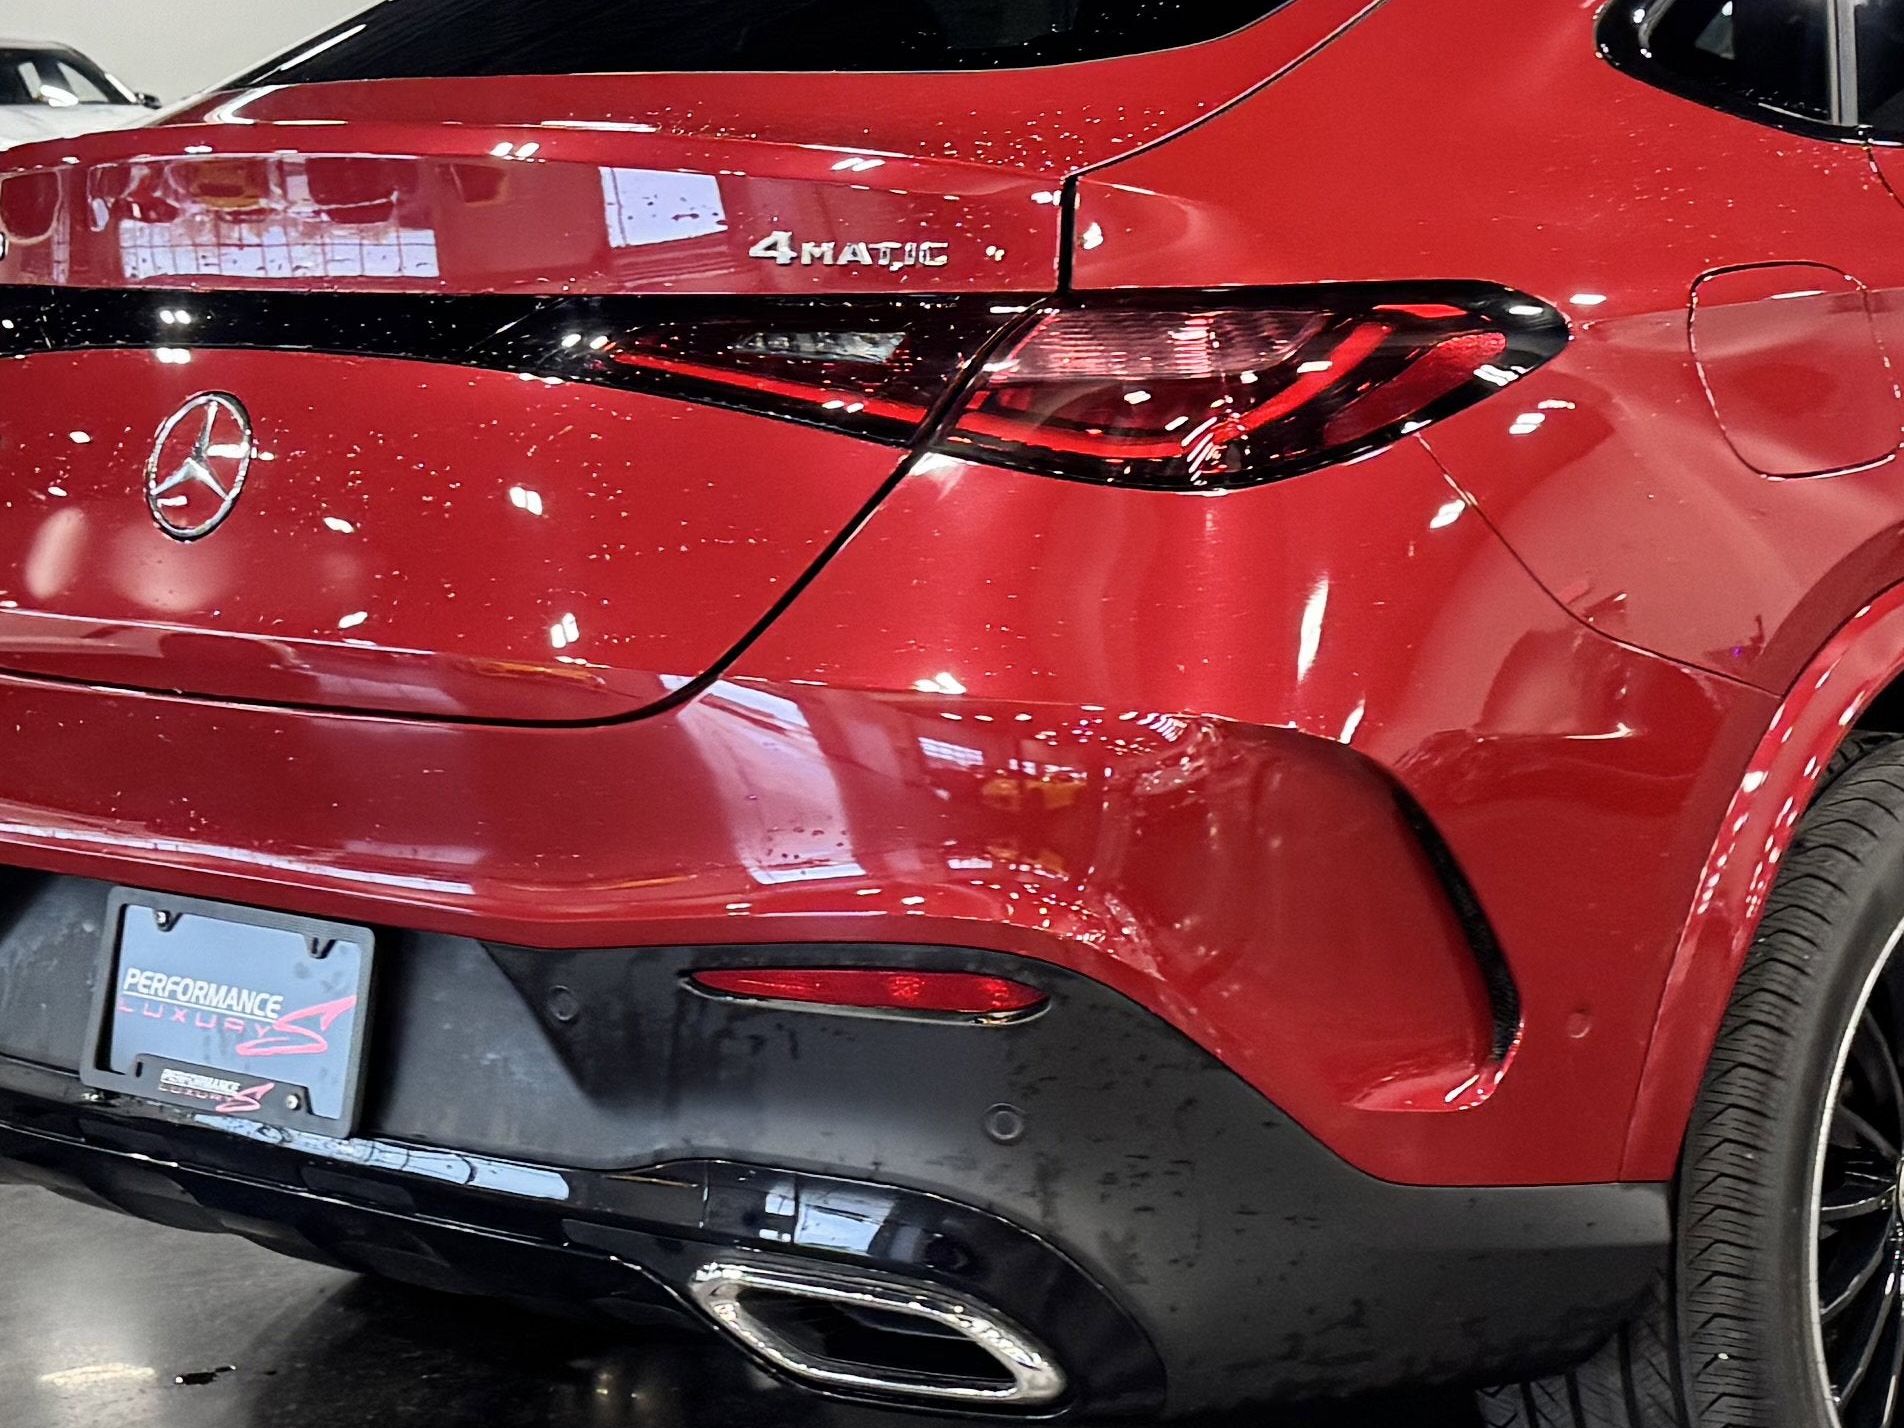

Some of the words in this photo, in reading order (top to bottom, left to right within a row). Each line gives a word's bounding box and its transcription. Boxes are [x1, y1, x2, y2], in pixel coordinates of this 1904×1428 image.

[749, 230, 949, 266] 4MATIC
[123, 967, 284, 1019] PERFORMANCE
[117, 998, 271, 1038] LUXURY
